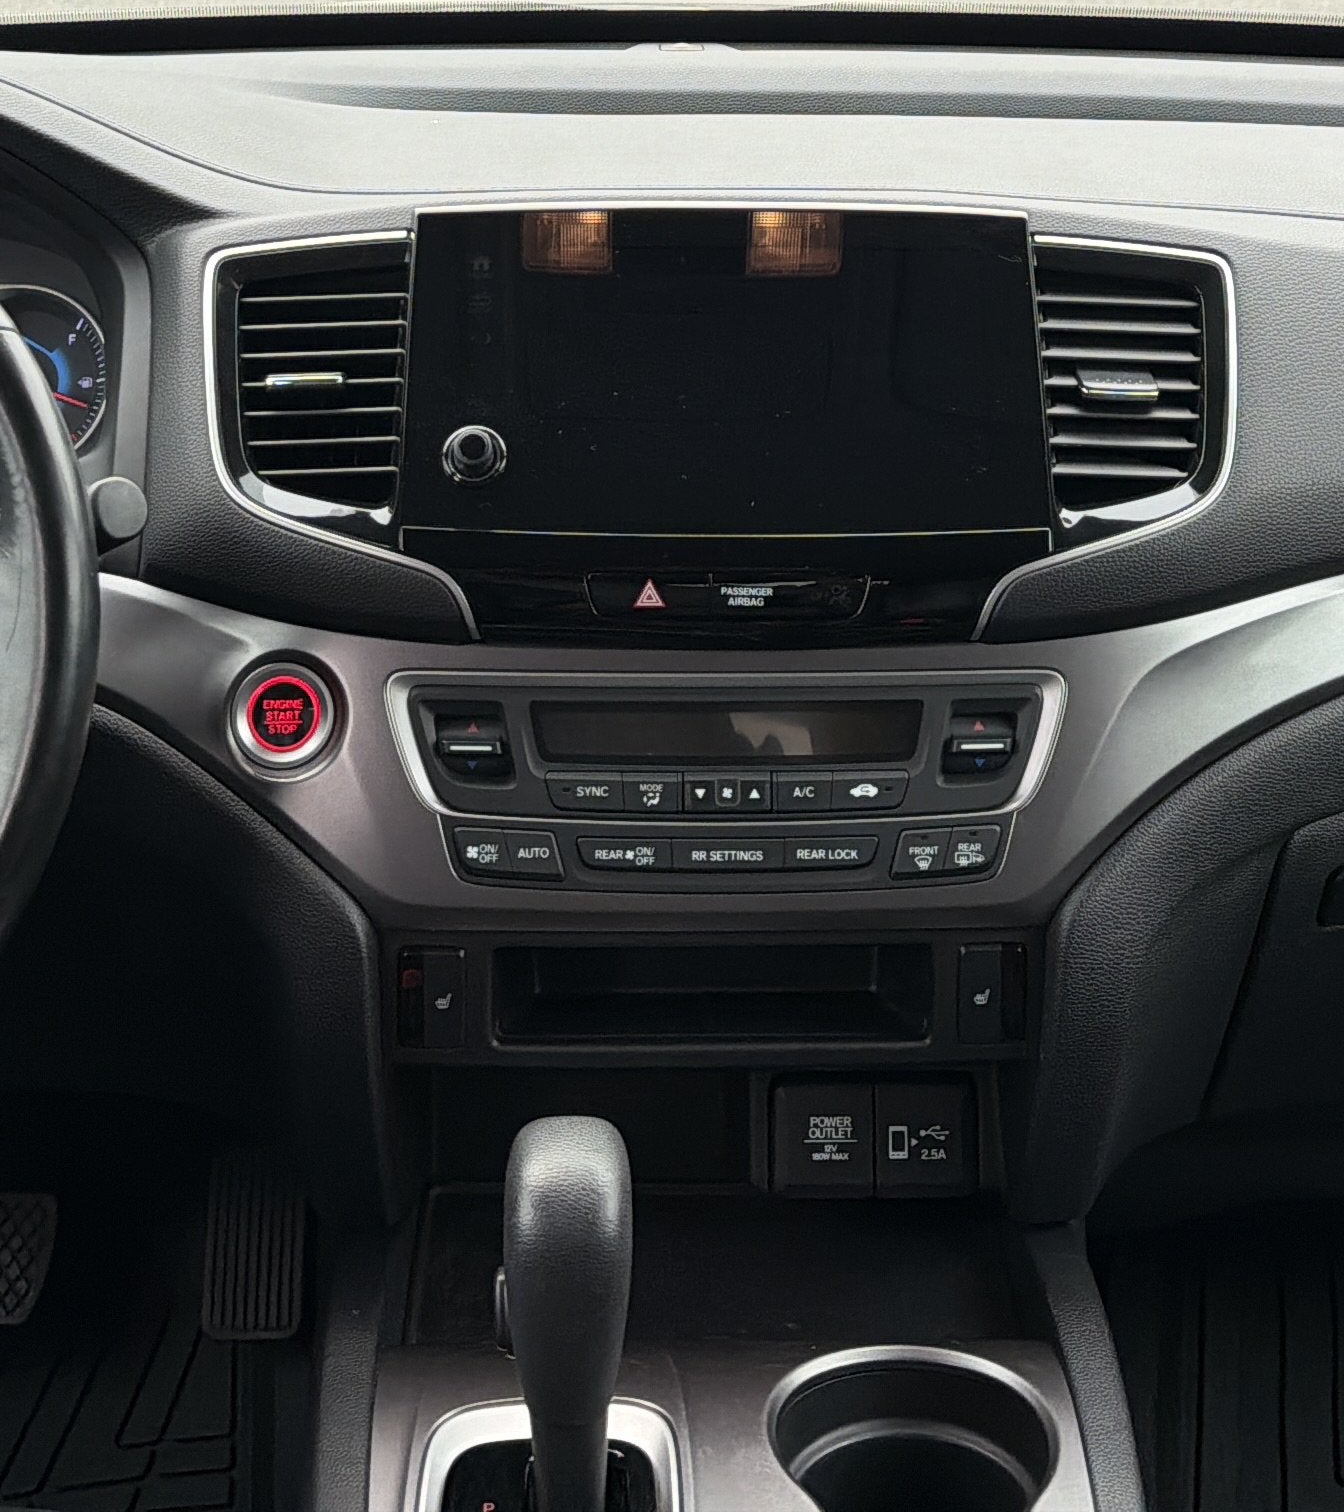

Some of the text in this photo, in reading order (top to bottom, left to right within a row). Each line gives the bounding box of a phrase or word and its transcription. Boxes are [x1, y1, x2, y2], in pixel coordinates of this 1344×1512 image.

[68, 333, 76, 346] F
[720, 586, 773, 597] PASSENGER
[727, 597, 765, 607] AIRBAG
[262, 697, 304, 710] ENGINE
[265, 710, 301, 721] START
[267, 723, 298, 735] STOP
[576, 786, 610, 798] SYNC
[639, 783, 664, 793] MODE
[793, 786, 815, 798] A/C
[908, 846, 939, 856] FRONT
[957, 842, 982, 852] REAR
[517, 847, 550, 859] AUTO
[594, 849, 624, 860] REAR
[691, 850, 764, 861] RR SETTINGS
[796, 848, 859, 860] REAR LOCK
[478, 854, 499, 864] OFF
[635, 856, 656, 866] OFF
[809, 1116, 852, 1127] POWER
[808, 1128, 853, 1139] OUTLET
[831, 1152, 849, 1161] MAX
[920, 1148, 946, 1160] 2.5A
